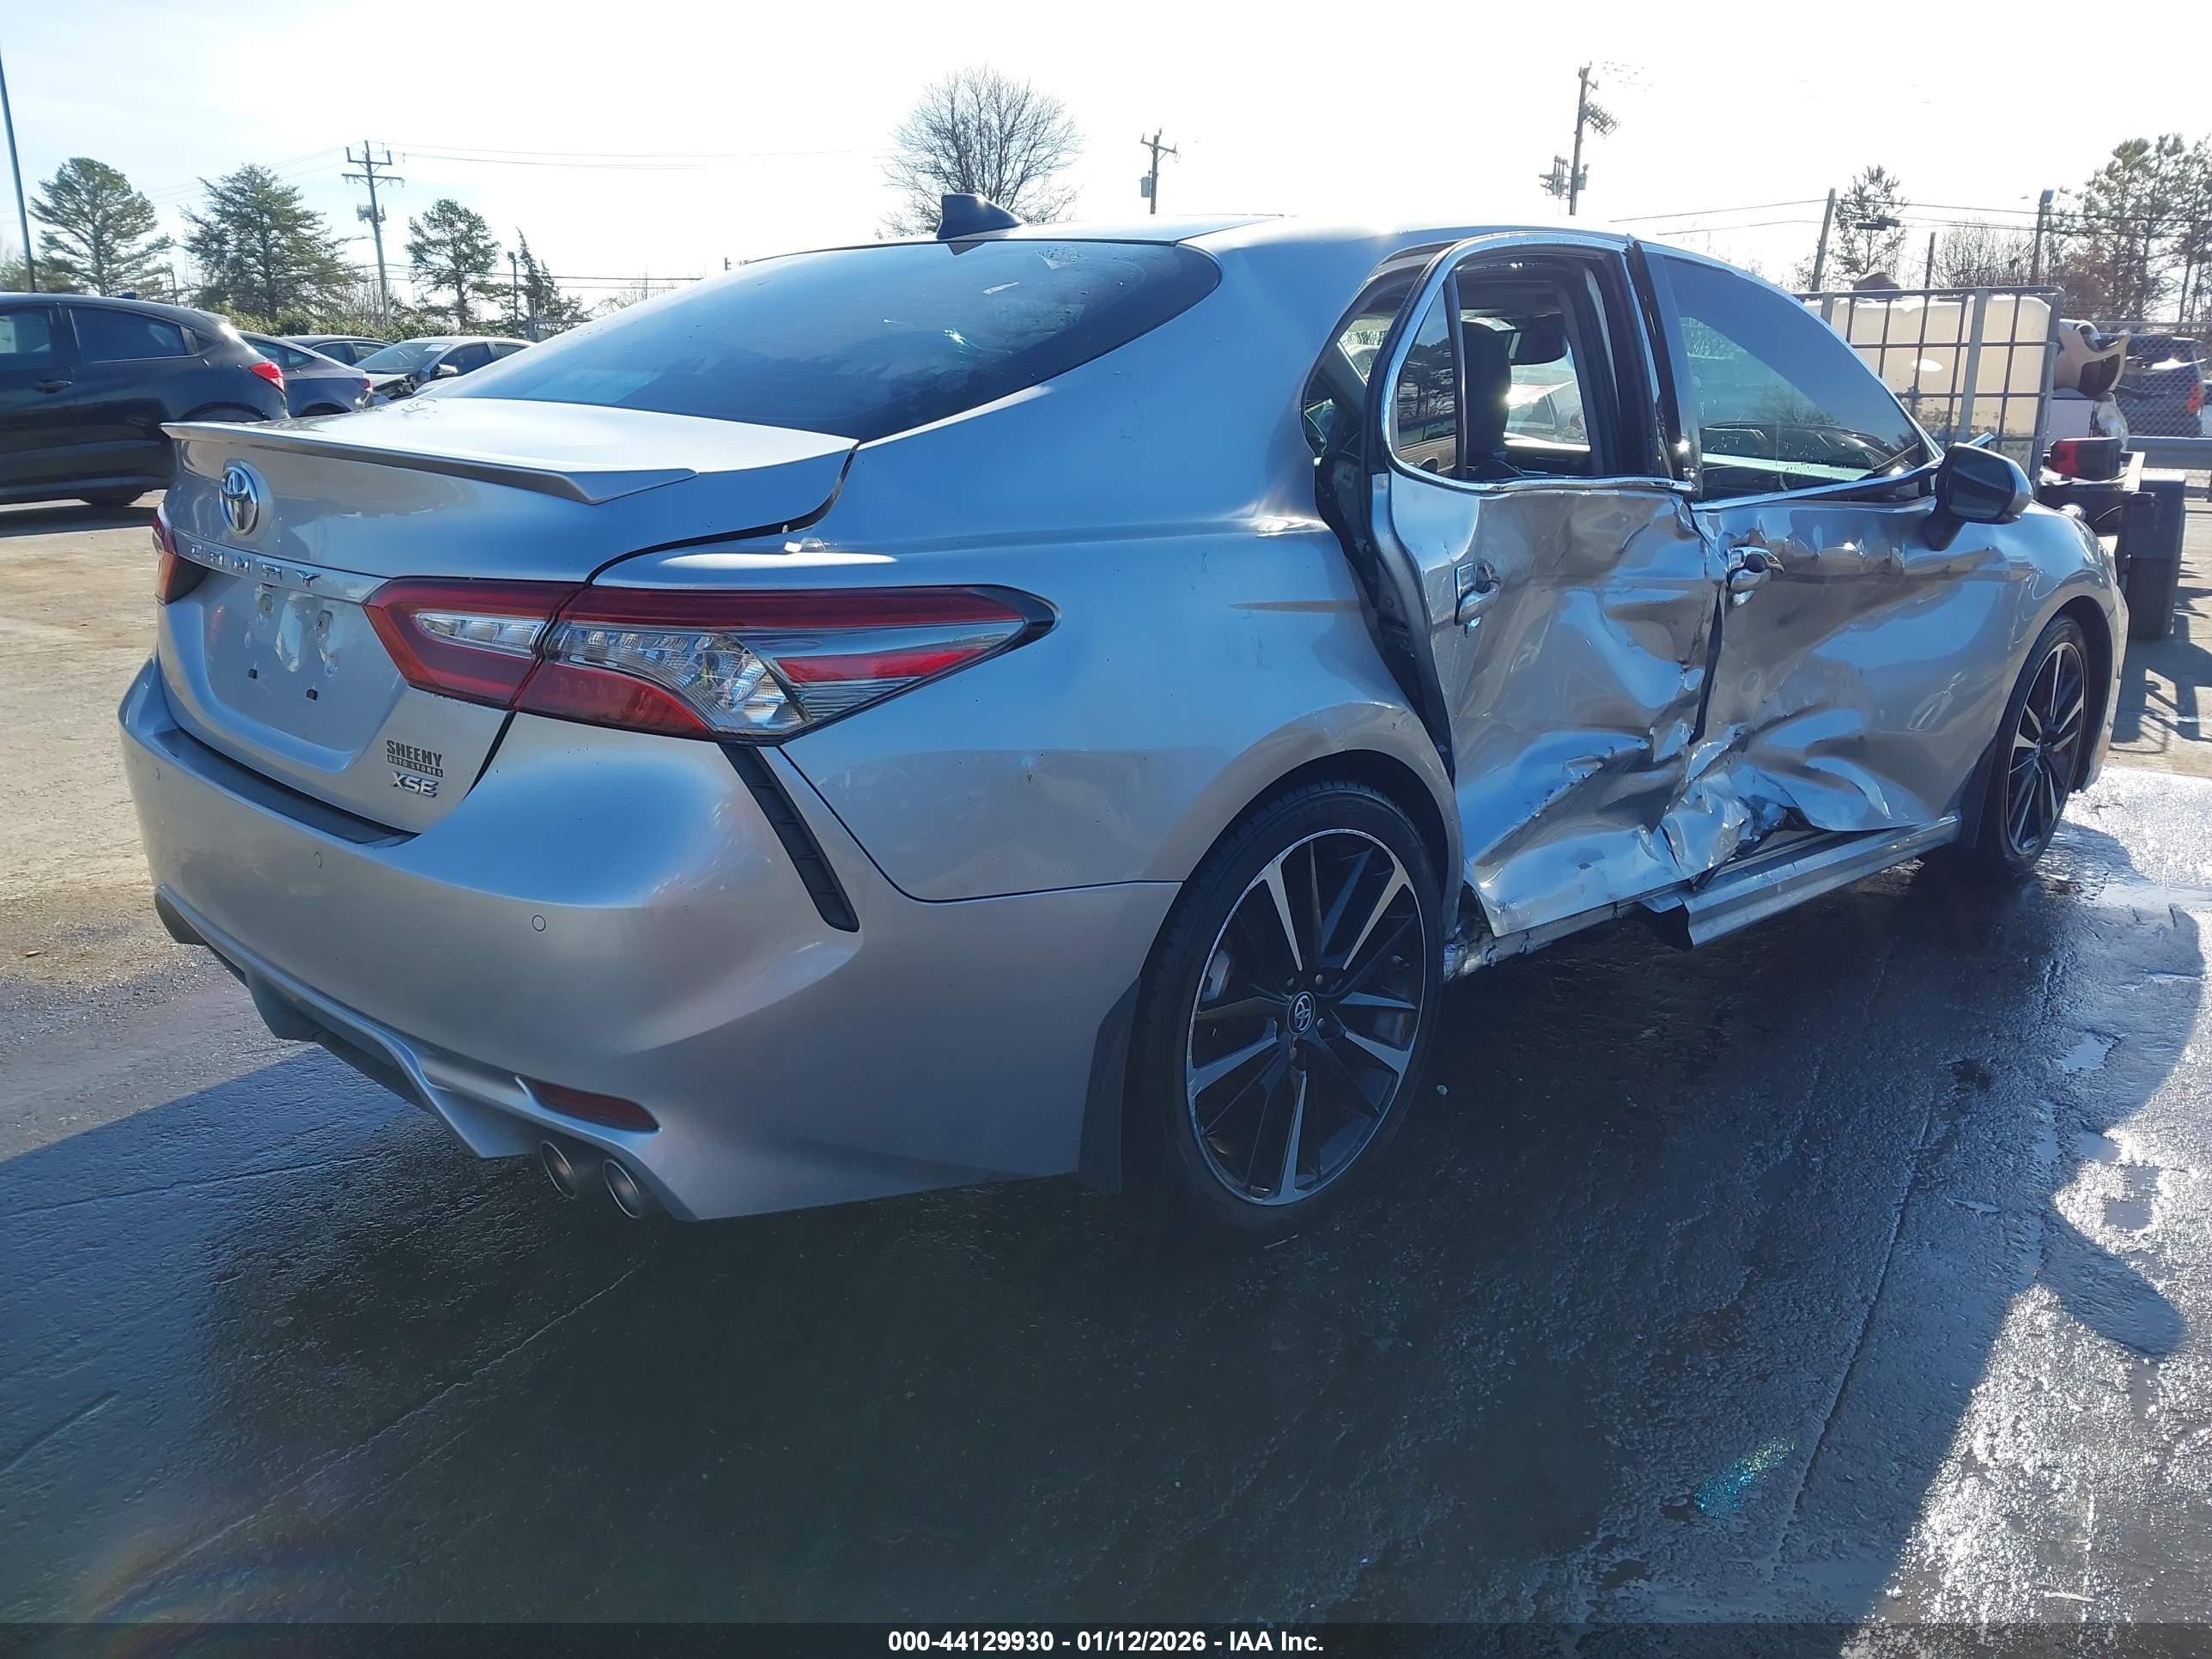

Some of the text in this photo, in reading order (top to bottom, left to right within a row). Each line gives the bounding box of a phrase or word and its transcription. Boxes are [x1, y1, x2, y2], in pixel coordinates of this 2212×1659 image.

[190, 544, 321, 587] CAMRY
[386, 739, 443, 768] SHEEHY
[388, 755, 442, 776] AUTO STORES
[392, 770, 439, 798] XSE
